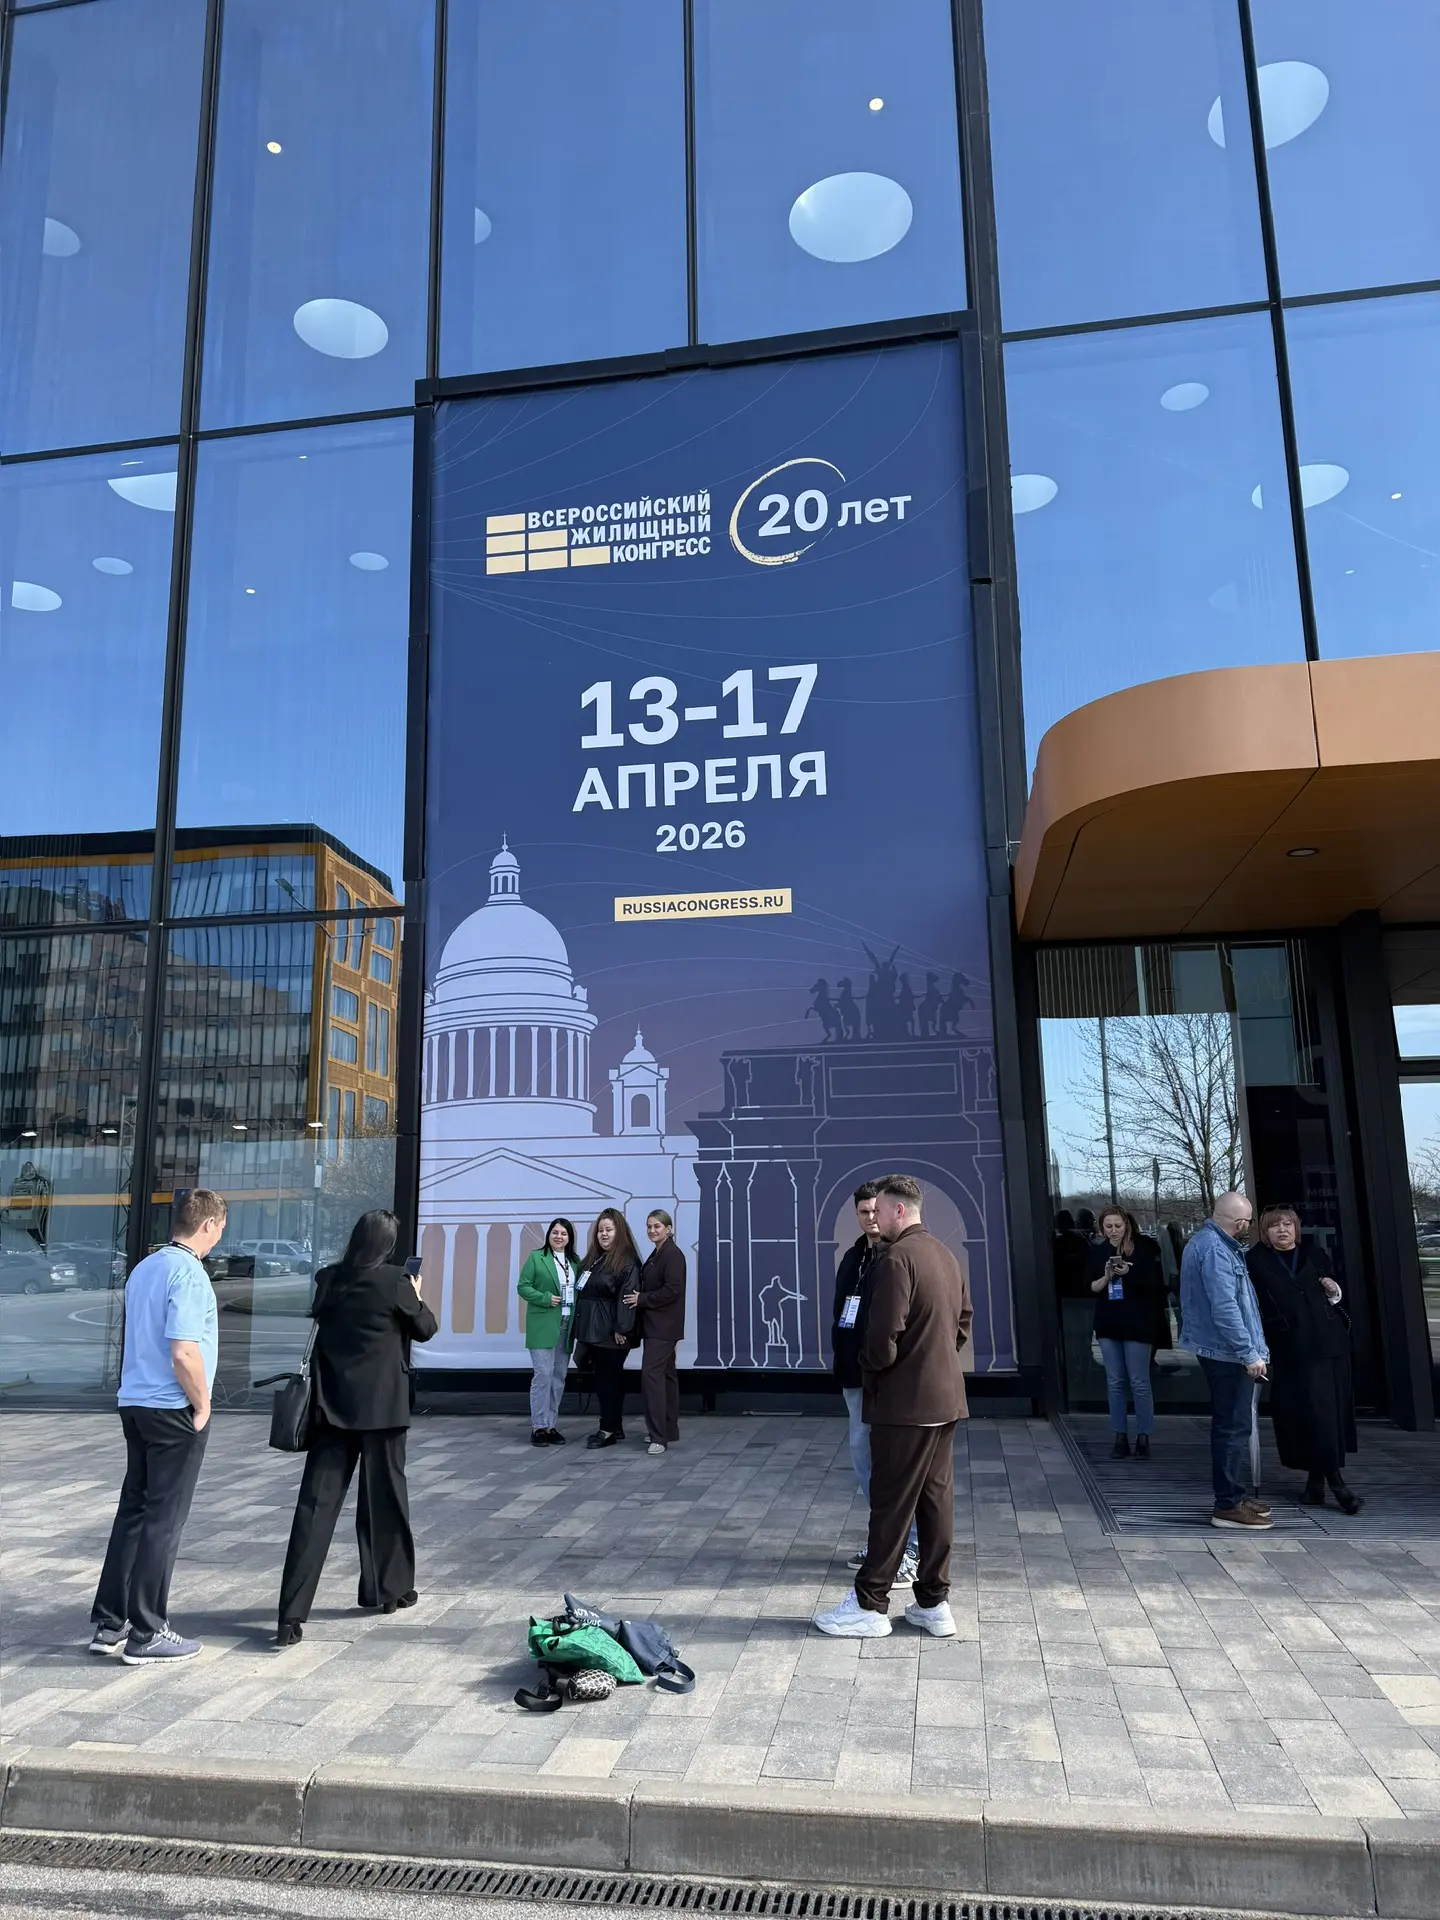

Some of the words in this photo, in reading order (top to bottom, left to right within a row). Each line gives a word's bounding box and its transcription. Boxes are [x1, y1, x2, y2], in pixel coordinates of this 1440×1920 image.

[527, 488, 711, 529] ВСЕРОССИЙСКИЙ
[758, 489, 829, 537] 20
[837, 495, 912, 527] лет
[570, 510, 711, 546] ЖИЛИЩНЫЙ
[613, 536, 711, 563] КОНГРЕСС
[572, 750, 827, 812] АПРЕЛЯ
[656, 820, 746, 853] 2026
[623, 896, 783, 915] RUSSIACONGRESS.RU
